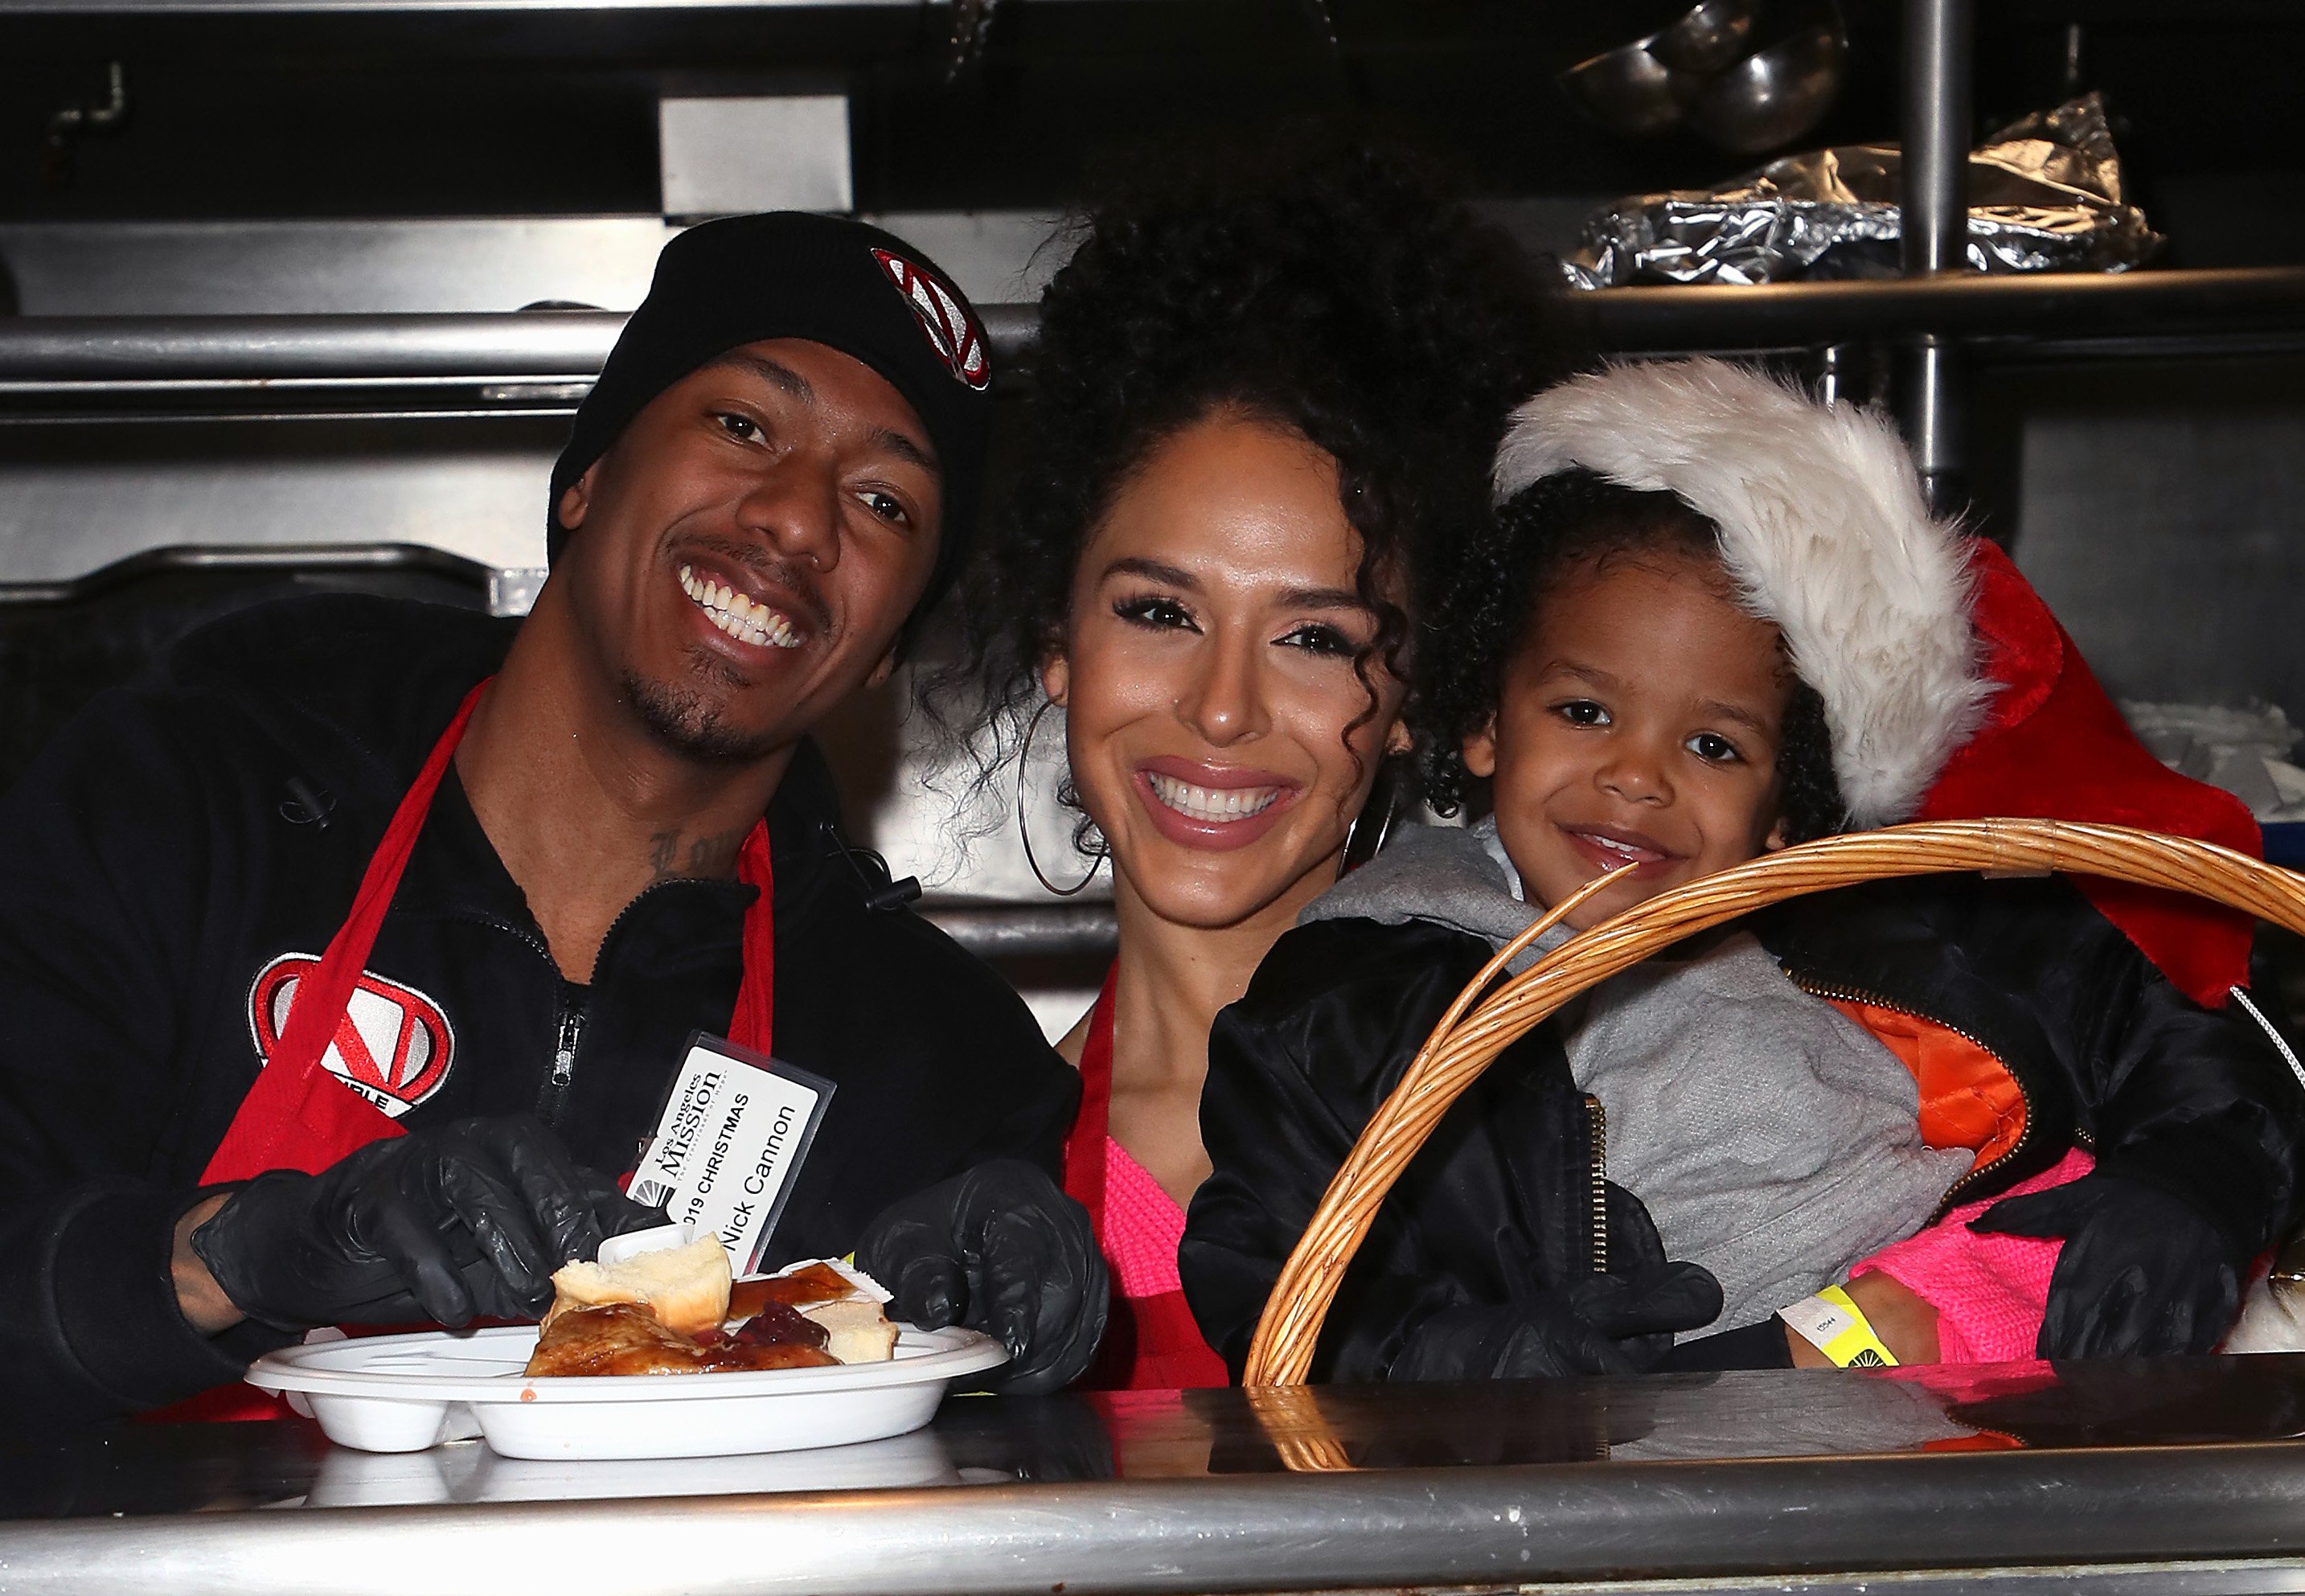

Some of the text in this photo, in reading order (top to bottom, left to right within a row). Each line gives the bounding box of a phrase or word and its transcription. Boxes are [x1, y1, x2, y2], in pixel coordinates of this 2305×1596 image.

[654, 1073, 702, 1164] Los Angeles
[683, 1093, 749, 1225] 019 CHRISTMAS
[720, 1105, 796, 1251] Nick Cannon
